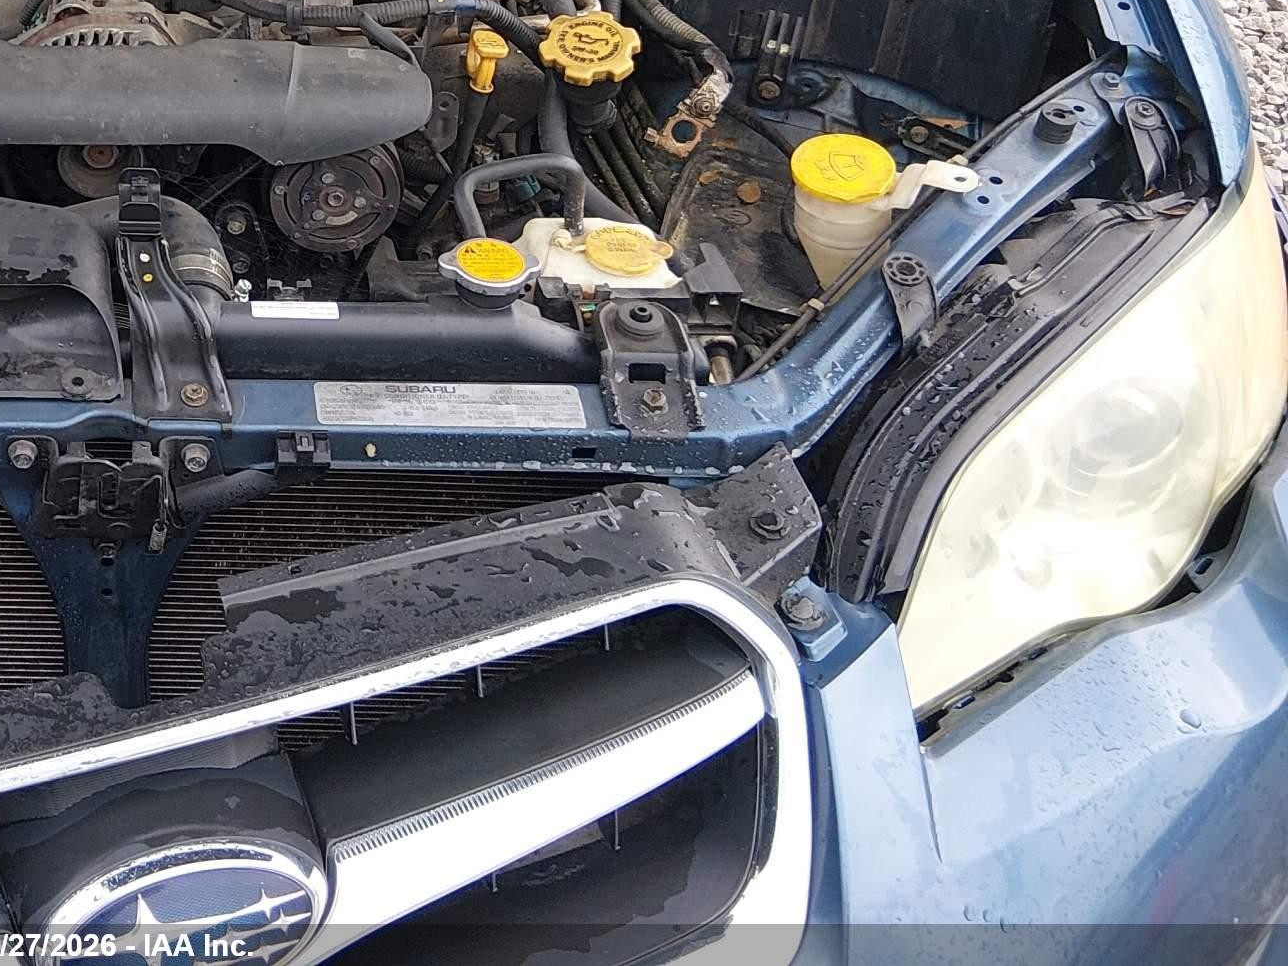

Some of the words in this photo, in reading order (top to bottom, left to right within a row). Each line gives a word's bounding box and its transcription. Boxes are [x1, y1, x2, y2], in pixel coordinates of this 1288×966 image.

[568, 20, 604, 30] ENGINE
[605, 26, 619, 38] OIL
[385, 385, 457, 394] SUBARU
